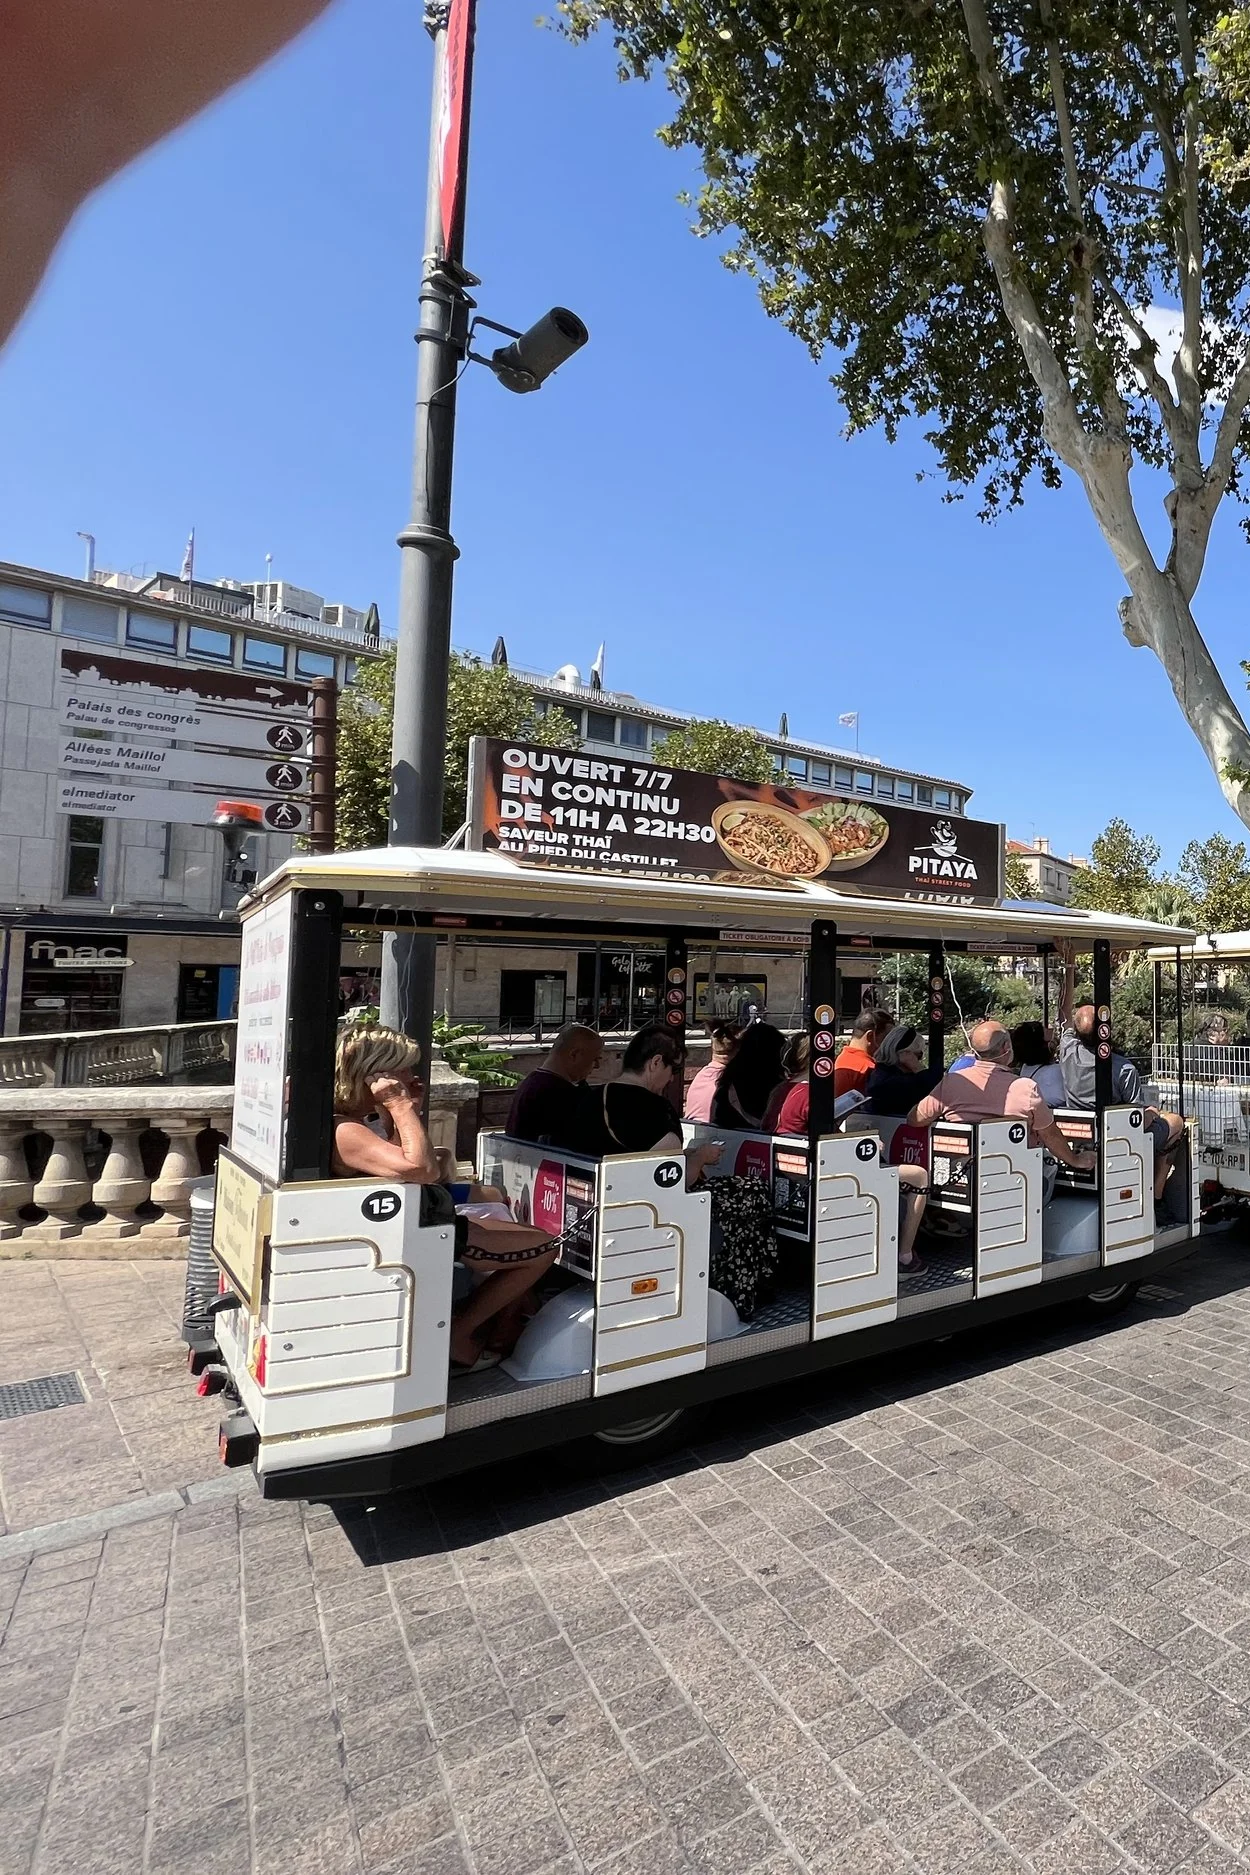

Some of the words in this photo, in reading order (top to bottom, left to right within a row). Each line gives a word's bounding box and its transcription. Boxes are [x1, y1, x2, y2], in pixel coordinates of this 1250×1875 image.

[67, 698, 112, 713] Palais
[117, 706, 142, 717] des
[147, 711, 201, 725] congrès
[66, 712, 97, 723] Palau
[101, 717, 114, 725] de
[118, 720, 176, 732] congressos
[65, 741, 111, 755] Allées
[117, 747, 166, 762] Maillol
[63, 754, 120, 768] Passejada
[124, 761, 161, 773] Maillol
[502, 748, 626, 783] OUVERT
[631, 767, 673, 790] 7/7
[62, 787, 136, 802] elmediator
[501, 773, 544, 797] EN
[551, 781, 680, 815] CONTINU
[61, 801, 117, 812] elmediator
[500, 799, 543, 823] DE
[550, 806, 600, 830] 11H
[606, 813, 628, 833] A
[633, 816, 716, 844] 22H30
[498, 826, 569, 845] SAVEUR
[572, 833, 613, 849] THAÏ
[498, 840, 523, 852] AU
[528, 843, 567, 857] PIED
[571, 848, 596, 859] DU
[908, 855, 978, 880] PITAYA
[931, 878, 953, 886] STREET
[722, 932, 743, 940] TICKET
[745, 933, 785, 942] OBLIGATOIRE
[29, 940, 122, 959] fnac
[1132, 1114, 1140, 1124] 11
[1011, 1129, 1022, 1139] 12
[860, 1143, 873, 1155] 13
[900, 1147, 921, 1164] -10%
[659, 1166, 679, 1182] 14
[369, 1197, 395, 1214] 15
[541, 1189, 557, 1214] -10%
